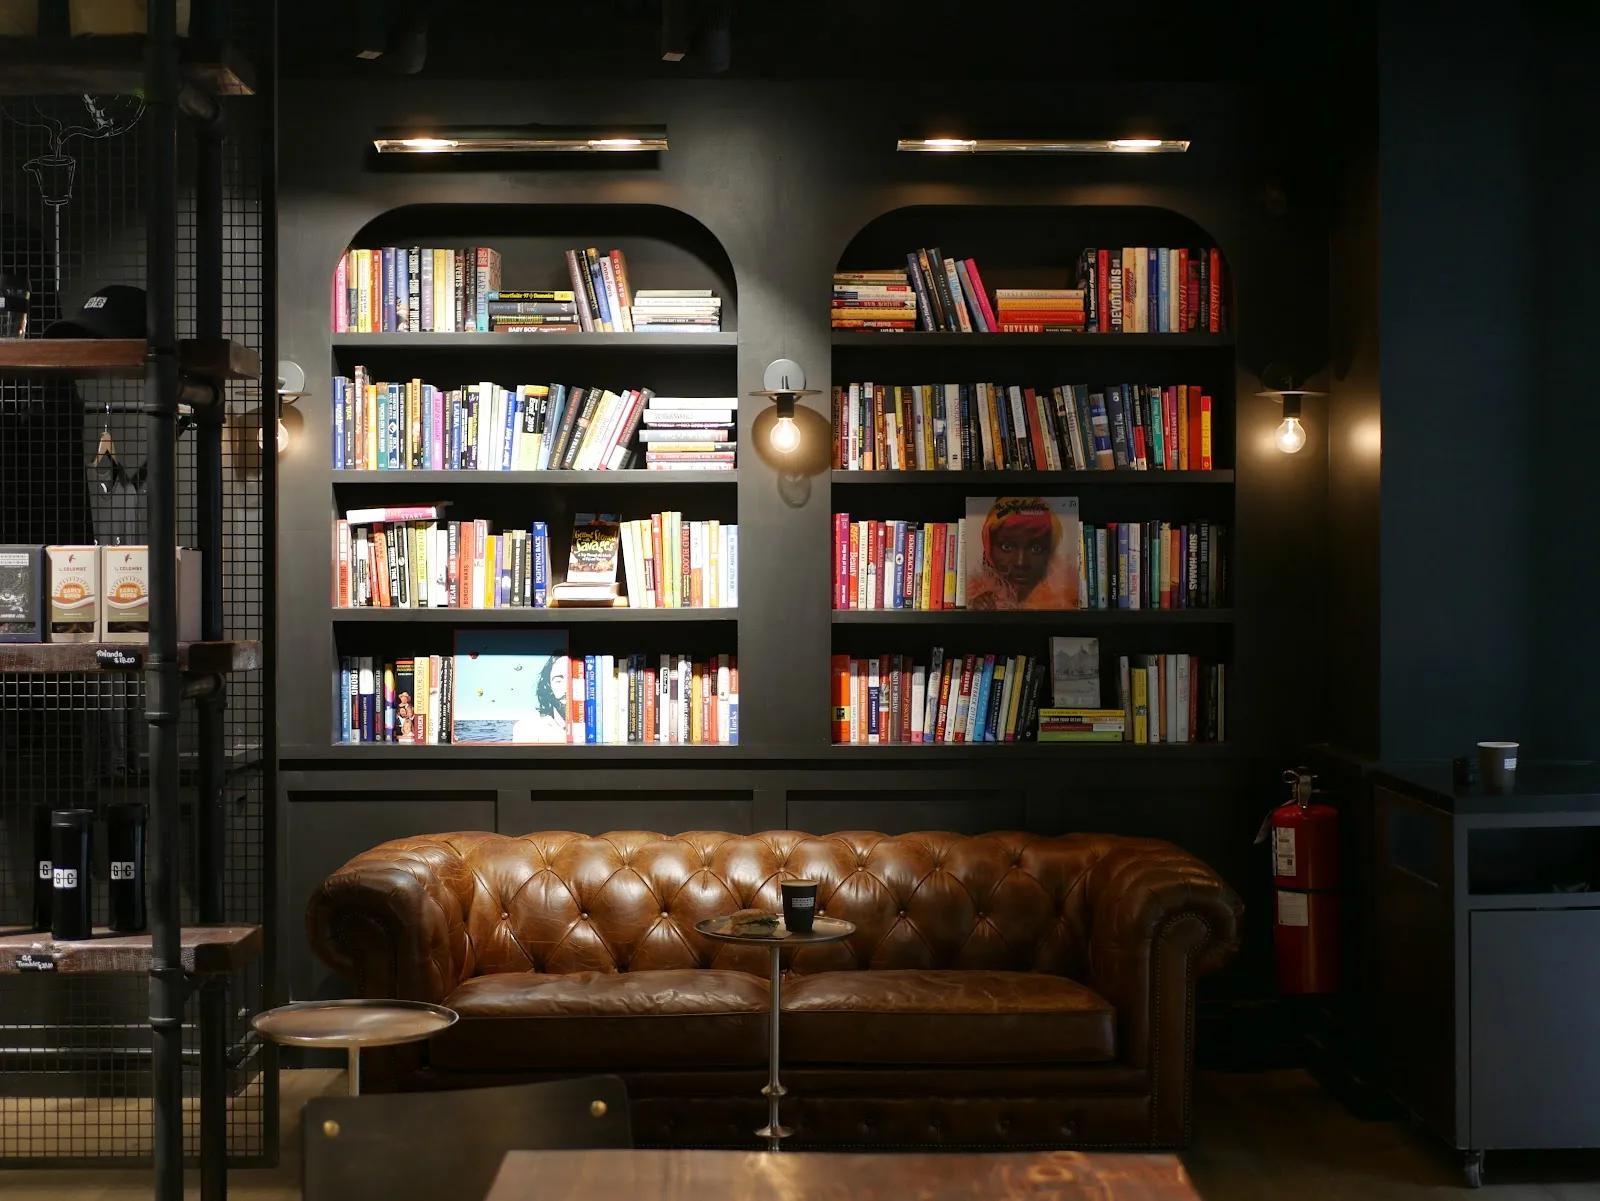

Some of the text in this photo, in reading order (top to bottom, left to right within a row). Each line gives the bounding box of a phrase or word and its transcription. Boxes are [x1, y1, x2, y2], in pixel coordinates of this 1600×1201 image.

[423, 257, 432, 280] LIT
[950, 274, 963, 302] STAMPED
[1112, 268, 1122, 324] DEVOTIONS
[1171, 415, 1176, 426] AM
[1116, 427, 1124, 442] NIGHT
[565, 438, 579, 463] FRANKEN
[574, 539, 615, 553] Savages
[849, 552, 858, 577] Beauty
[1189, 534, 1197, 590] SON HAMAS
[96, 650, 123, 658] Rwanda
[589, 671, 594, 680] ON
[971, 674, 980, 705] COMEBACK
[56, 872, 74, 884] GC
[113, 865, 132, 877] GC
